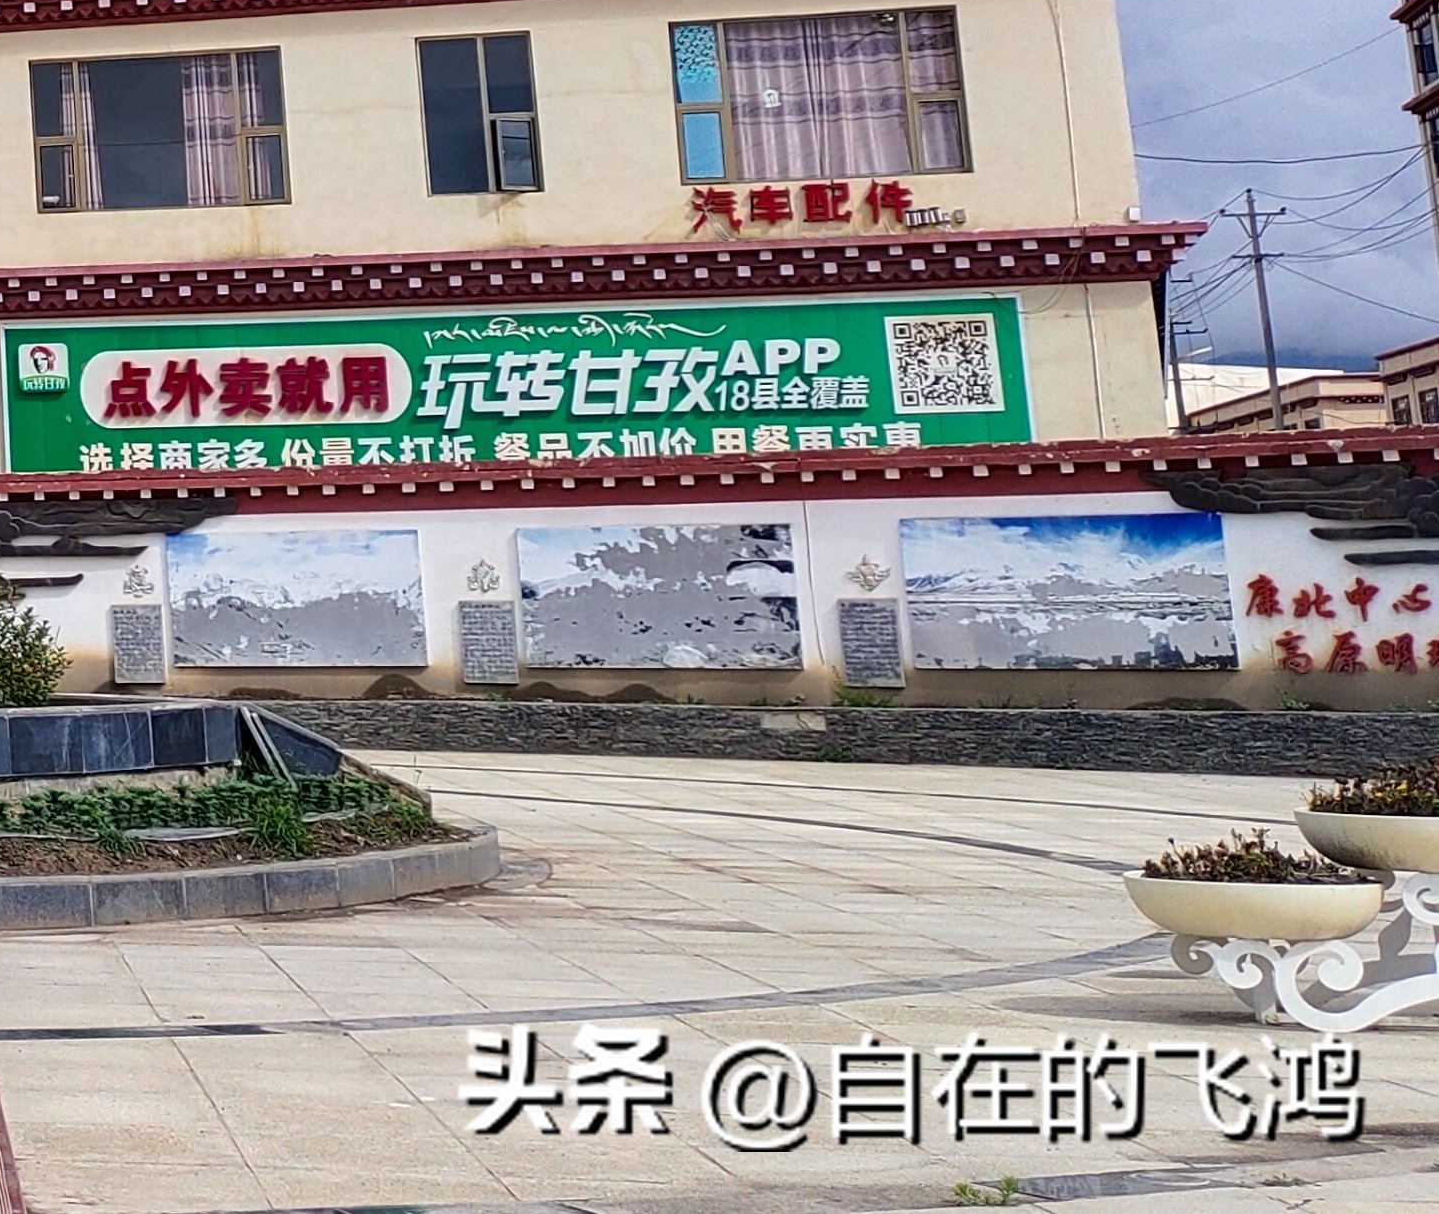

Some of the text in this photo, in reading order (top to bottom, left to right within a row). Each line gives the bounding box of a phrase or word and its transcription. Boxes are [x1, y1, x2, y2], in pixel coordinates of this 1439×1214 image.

[690, 179, 913, 234] 汽车配件
[103, 356, 390, 418] 点外卖就用
[416, 338, 841, 429] 玩转甘孜 APP
[715, 375, 870, 412] 18县全覆盖
[79, 438, 268, 472] 选择商家多
[281, 434, 475, 467] 份量不打折
[493, 427, 697, 461] 餐品不加价
[1246, 574, 1432, 622] 康北中心
